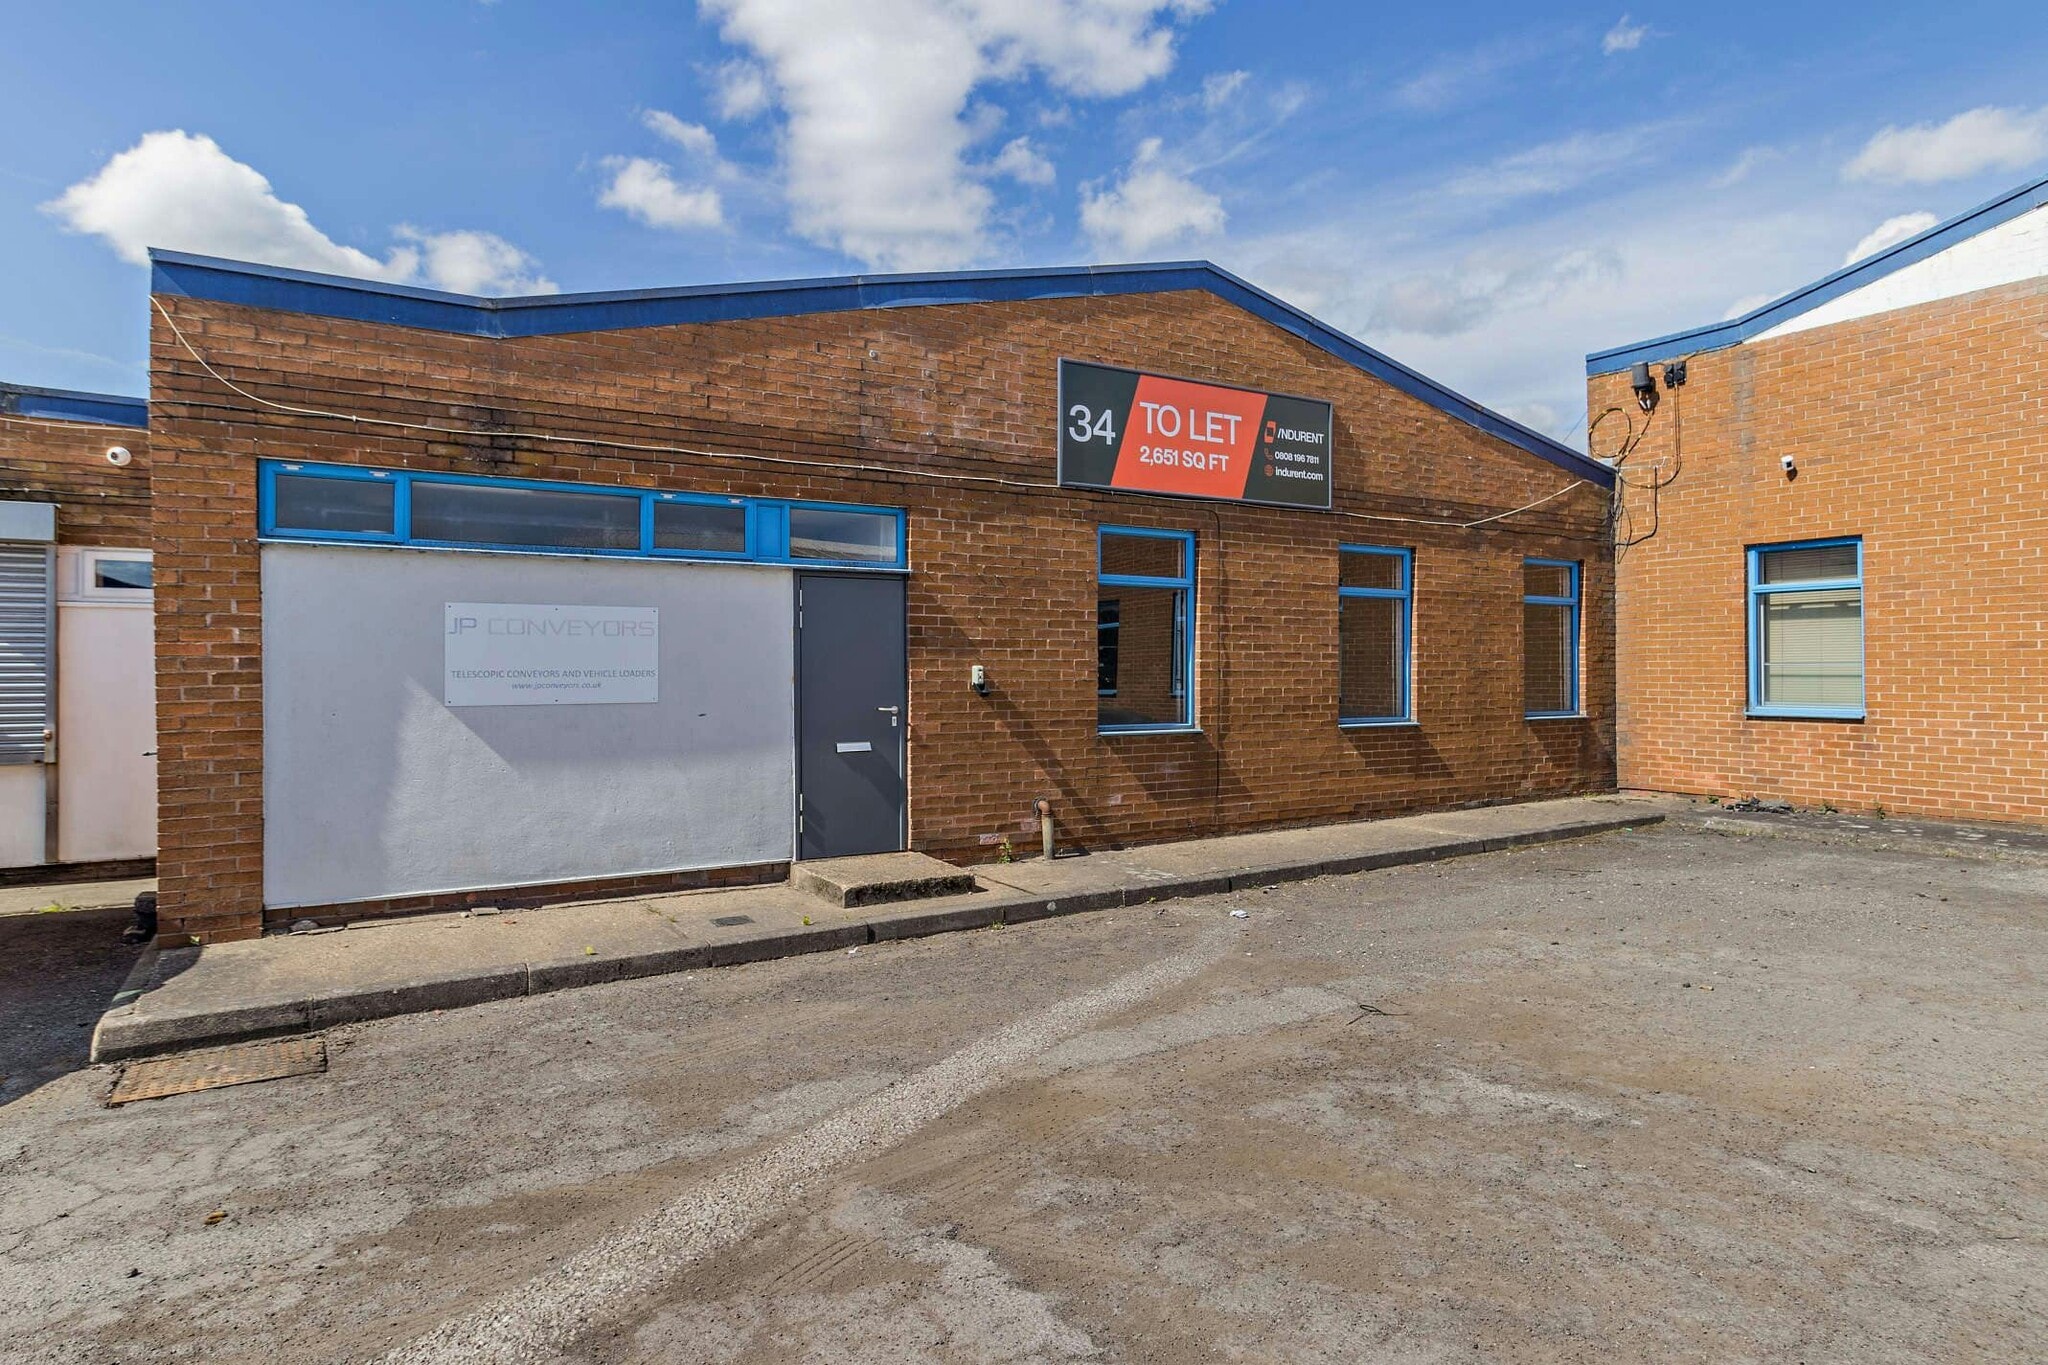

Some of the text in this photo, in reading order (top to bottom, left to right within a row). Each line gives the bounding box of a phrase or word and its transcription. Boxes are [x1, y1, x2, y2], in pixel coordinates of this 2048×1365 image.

[1068, 404, 1116, 446] 34
[1139, 401, 1242, 445] TO LET
[1139, 445, 1229, 472] 2,651 SQ FT
[1274, 451, 1294, 461] 0808
[1294, 453, 1306, 463] 196
[1275, 465, 1324, 482] indurent.com
[449, 617, 656, 637] JP CONVEYORS
[451, 669, 657, 679] TELESCOPIC CONVEYORS AND VEHICLE LOADERS
